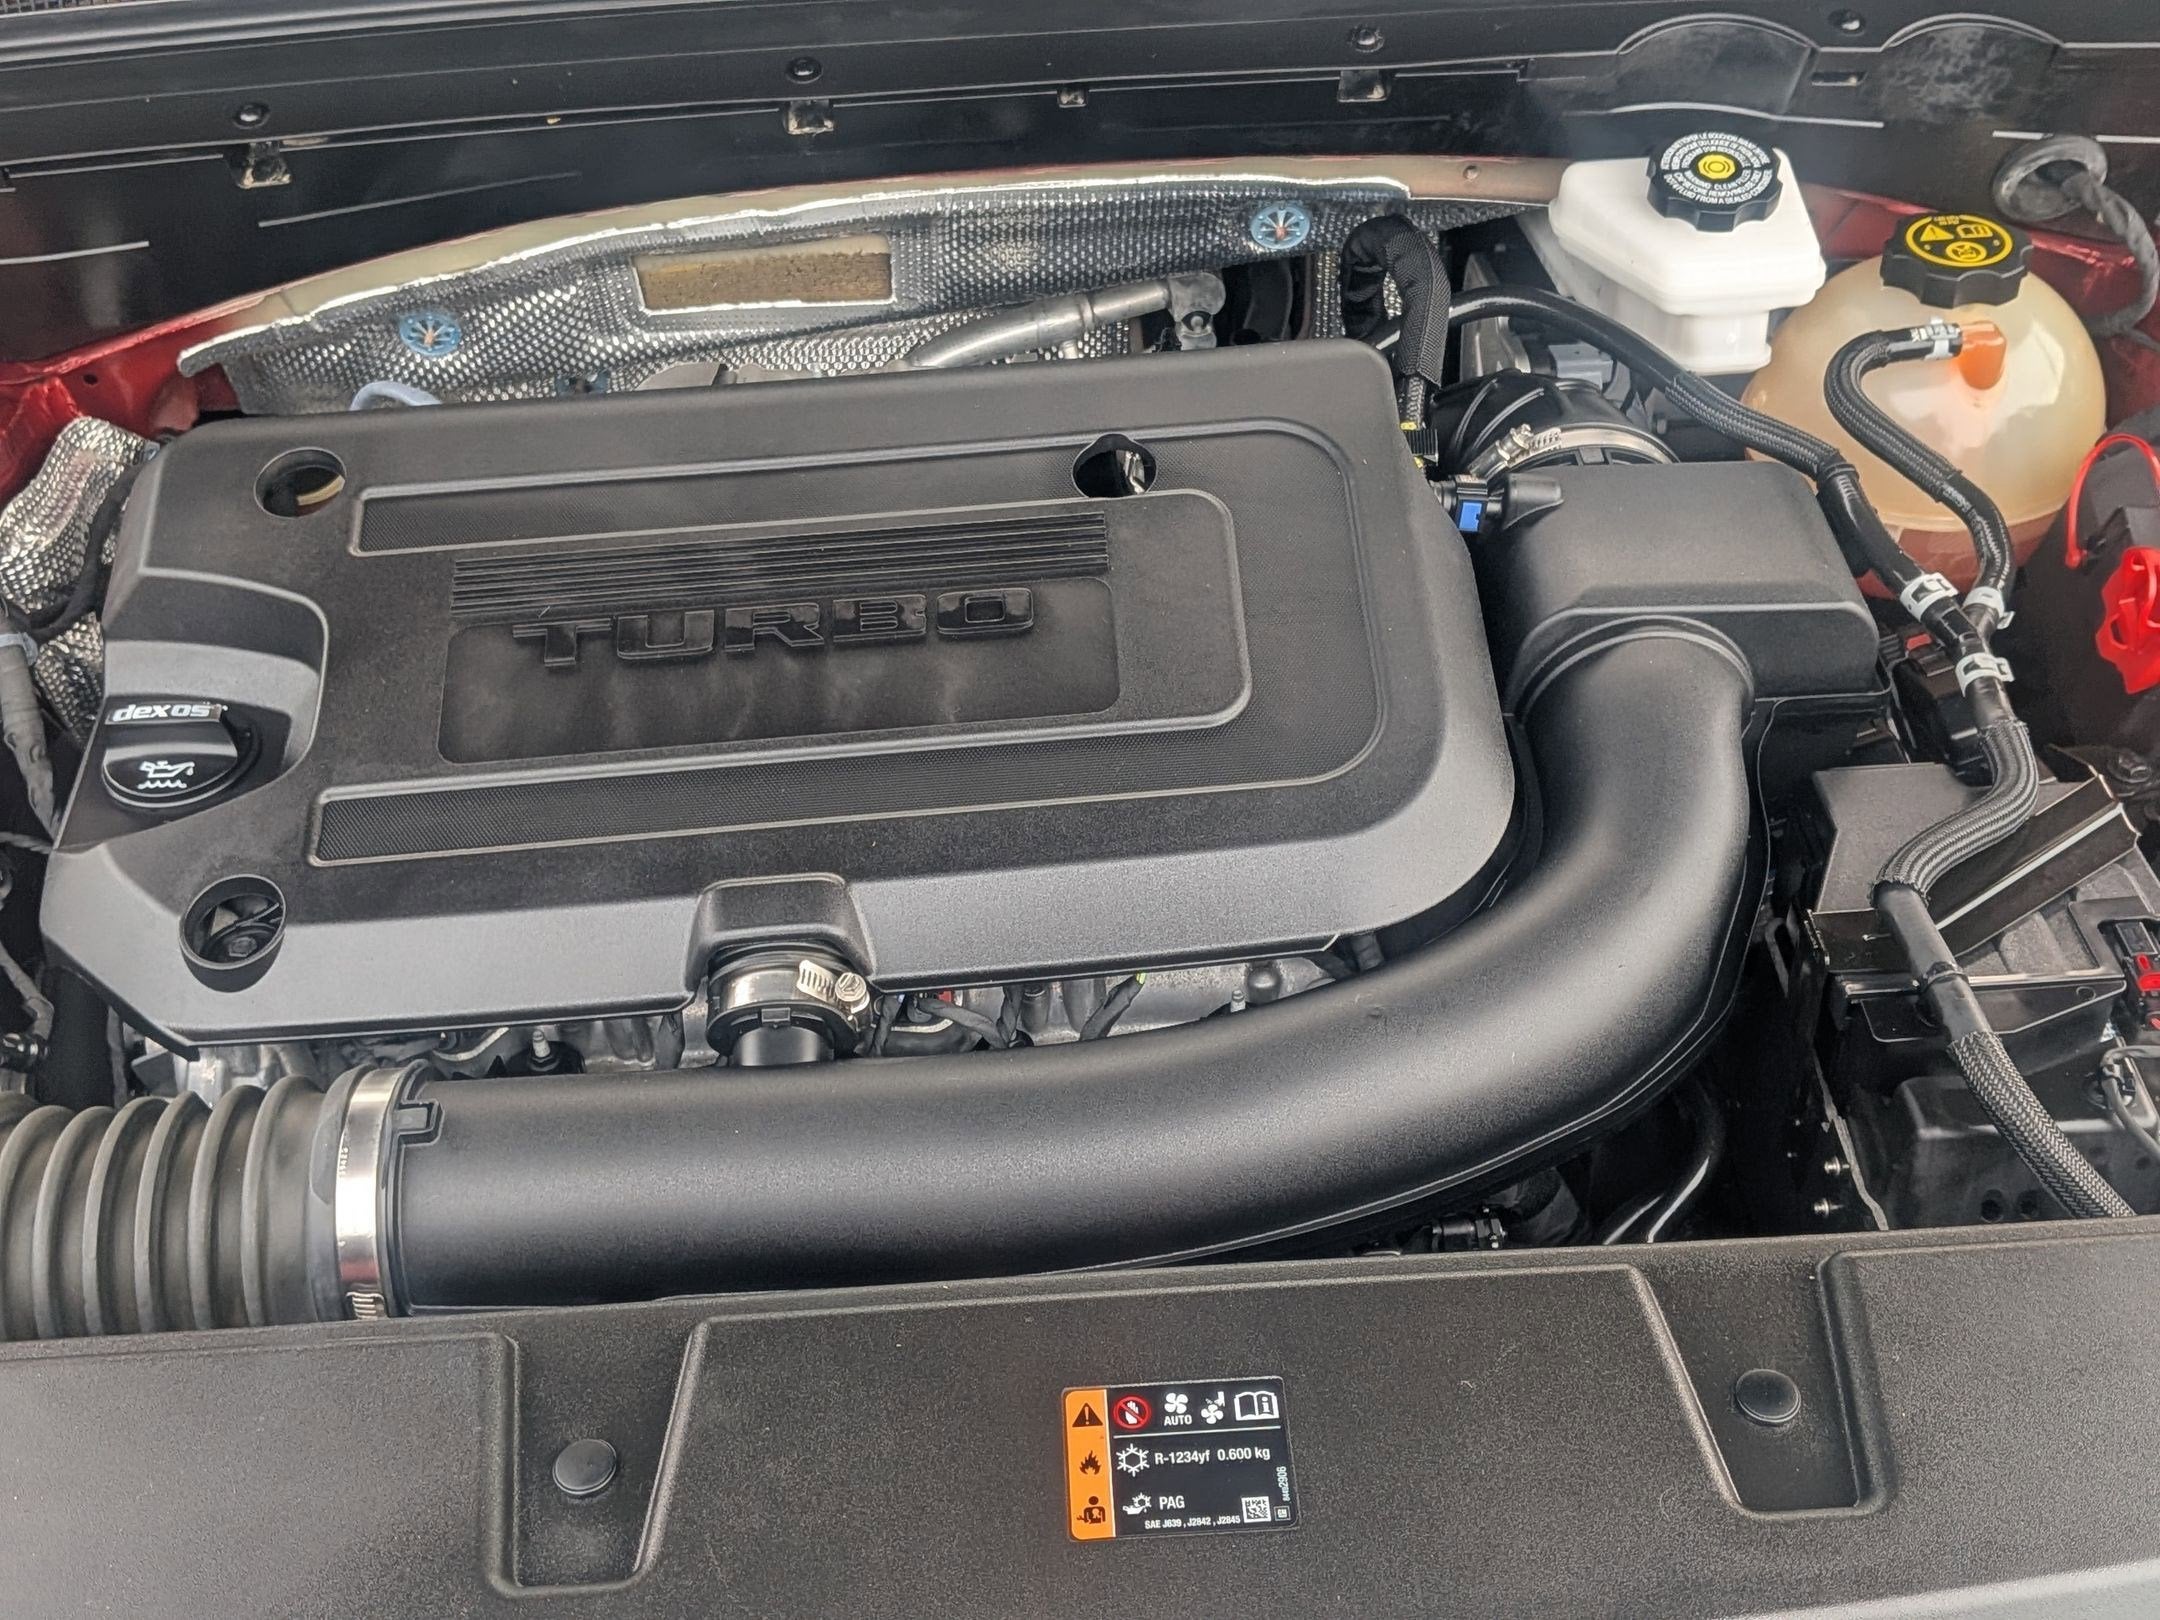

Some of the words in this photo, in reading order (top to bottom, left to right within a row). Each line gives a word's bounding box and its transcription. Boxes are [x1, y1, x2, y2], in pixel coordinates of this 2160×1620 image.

[1695, 194, 1718, 204] FROM
[512, 587, 1034, 667] TURBO
[112, 703, 211, 722] dexos
[1163, 1414, 1193, 1427] AUTO
[1154, 1450, 1210, 1466] R-1234yf
[1217, 1447, 1251, 1462] 0.600
[1254, 1446, 1271, 1461] kg
[1158, 1495, 1186, 1510] PAG
[1144, 1519, 1161, 1530] SAE
[1162, 1518, 1182, 1528] J639
[1187, 1516, 1211, 1527] J2842
[1216, 1514, 1241, 1525] J2845
